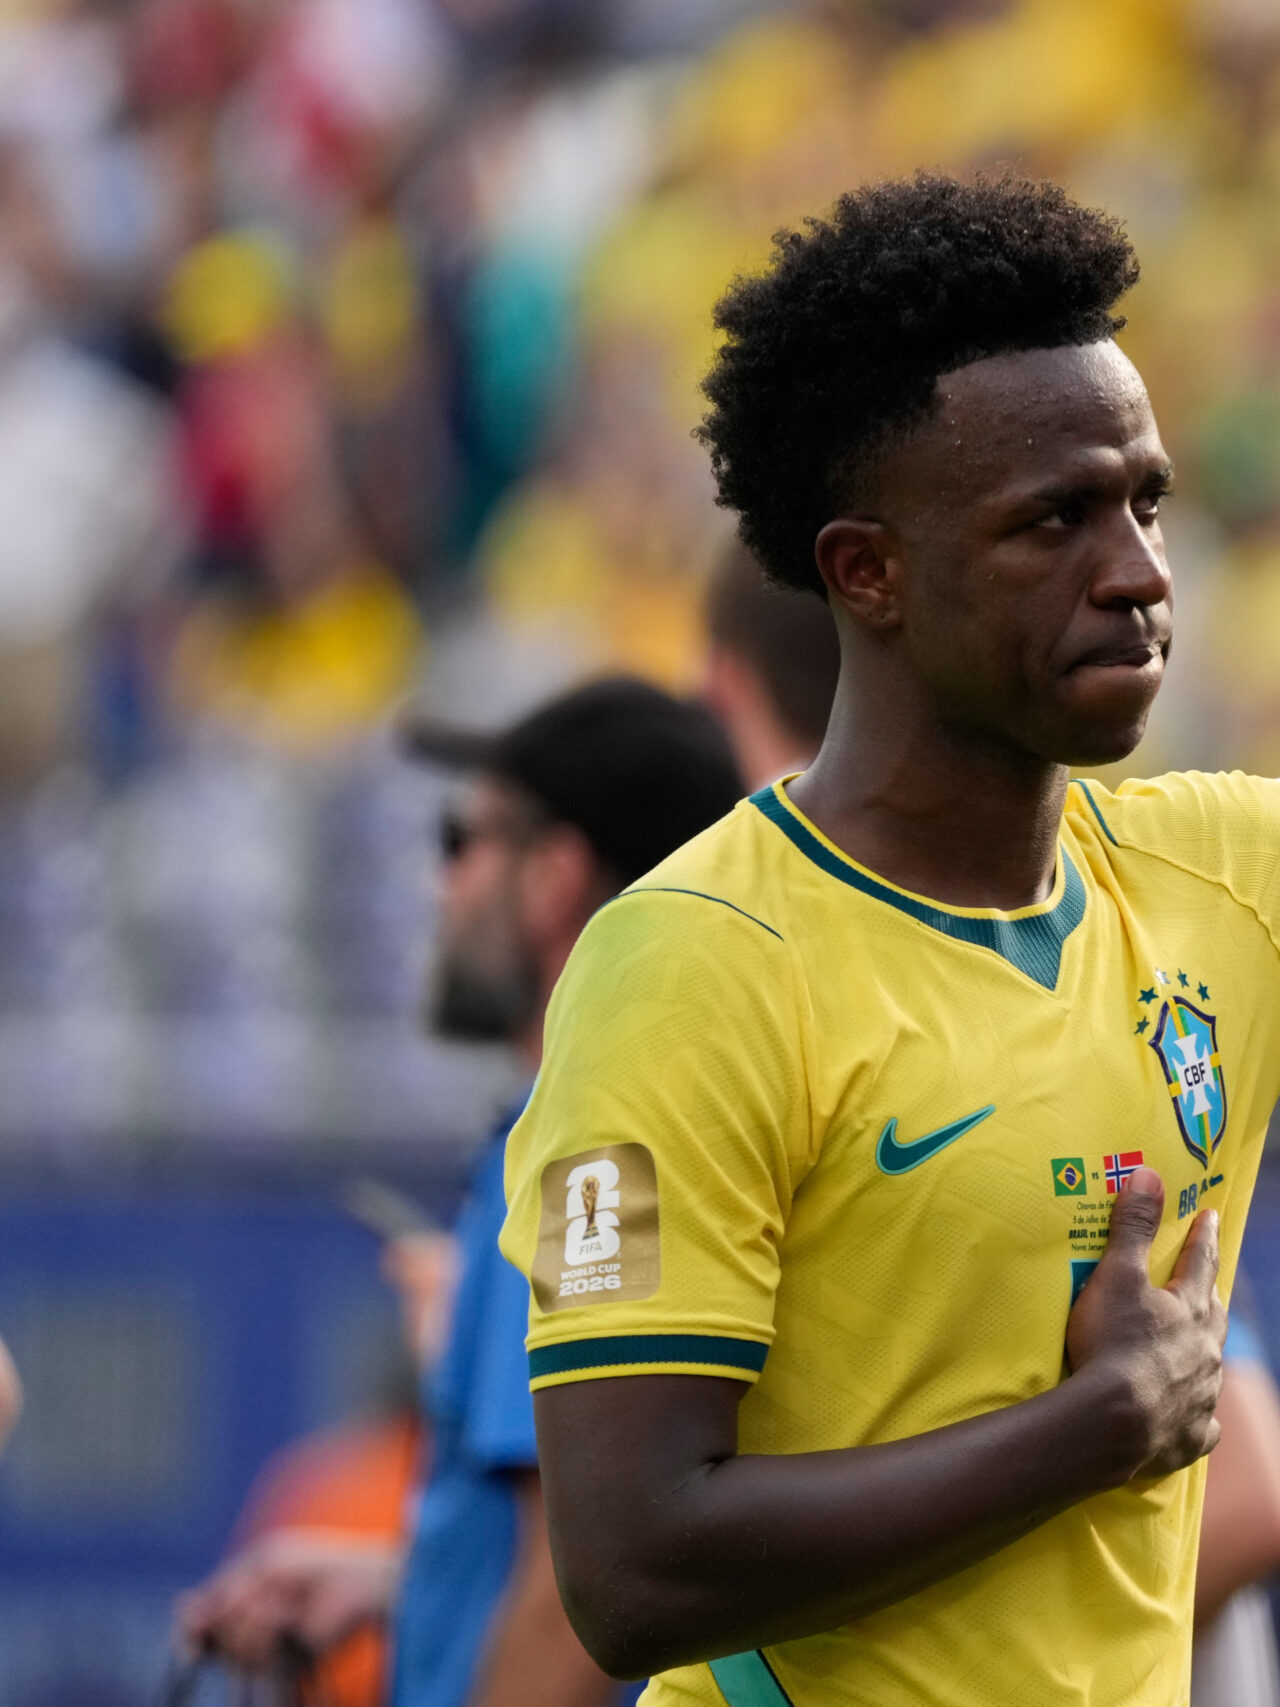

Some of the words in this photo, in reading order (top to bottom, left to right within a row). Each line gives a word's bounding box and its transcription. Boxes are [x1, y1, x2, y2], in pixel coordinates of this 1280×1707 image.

[1183, 1061, 1207, 1087] CBF
[1069, 1229, 1088, 1239] BRASIL
[578, 1241, 603, 1255] FIFA
[560, 1265, 596, 1281] WORLD
[598, 1263, 621, 1274] CUP
[558, 1274, 622, 1297] 2026
